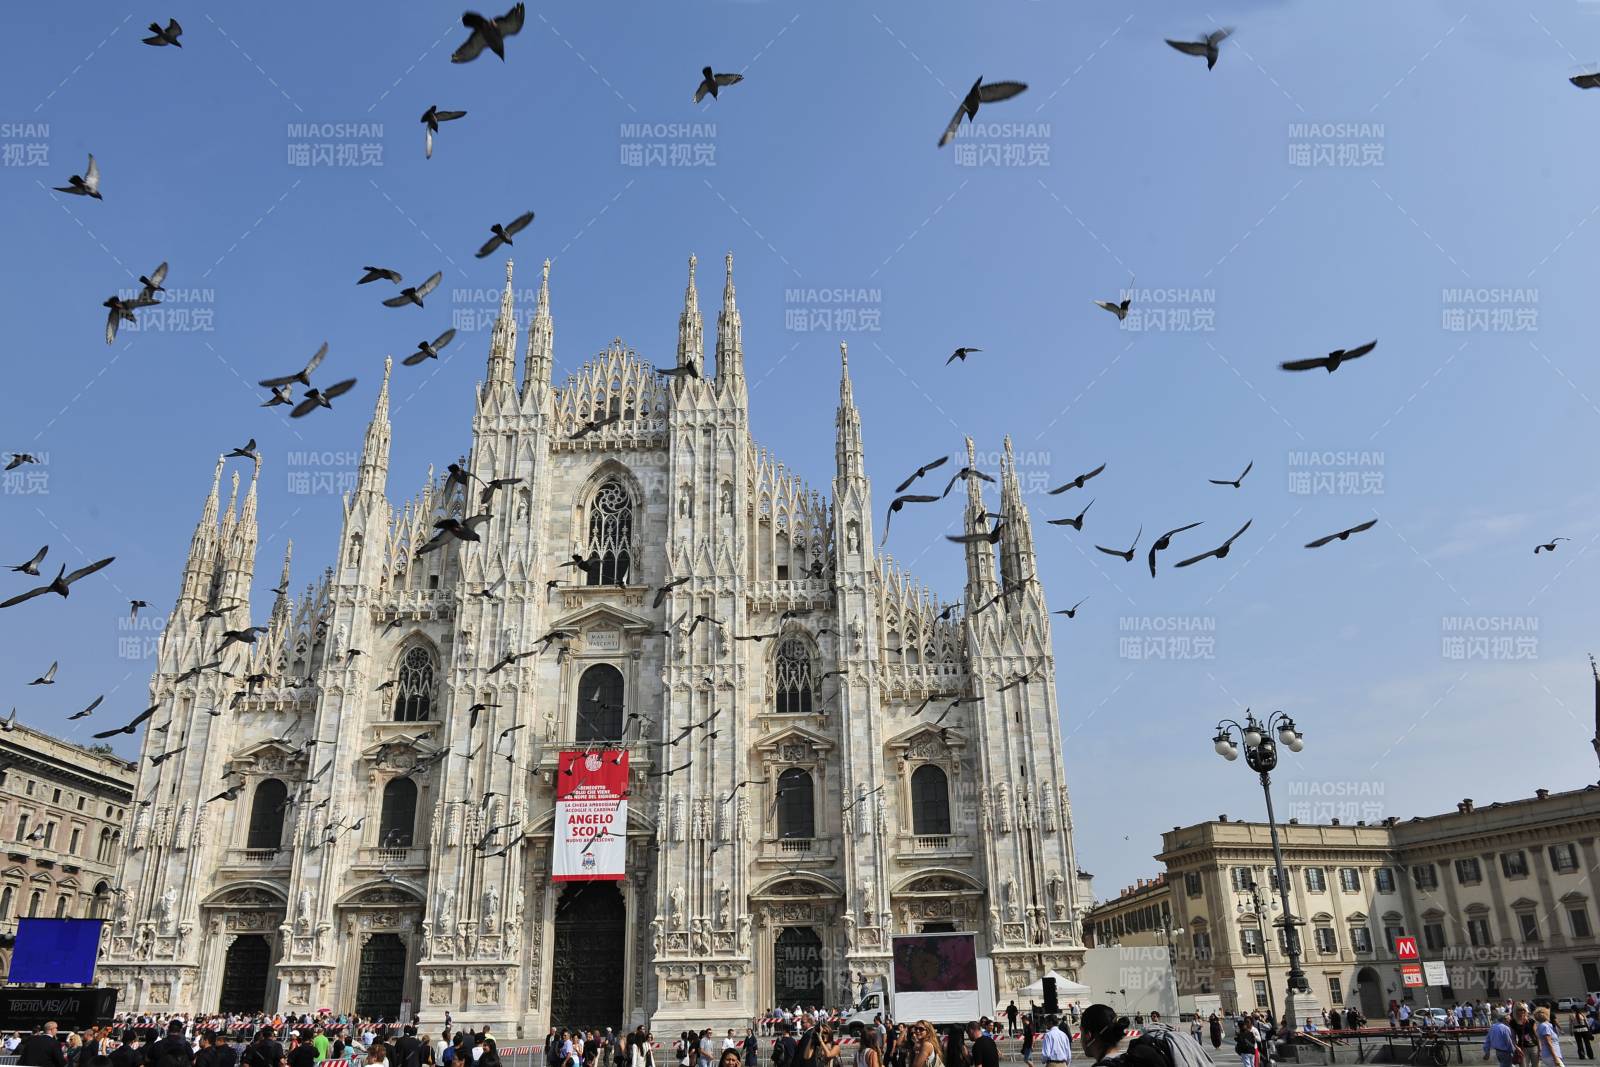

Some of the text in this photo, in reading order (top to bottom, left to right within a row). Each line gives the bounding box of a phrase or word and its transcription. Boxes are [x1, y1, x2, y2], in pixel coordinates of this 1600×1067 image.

[568, 814, 613, 824] ANGELO
[572, 826, 608, 836] SCOLA
[1399, 942, 1416, 955] M
